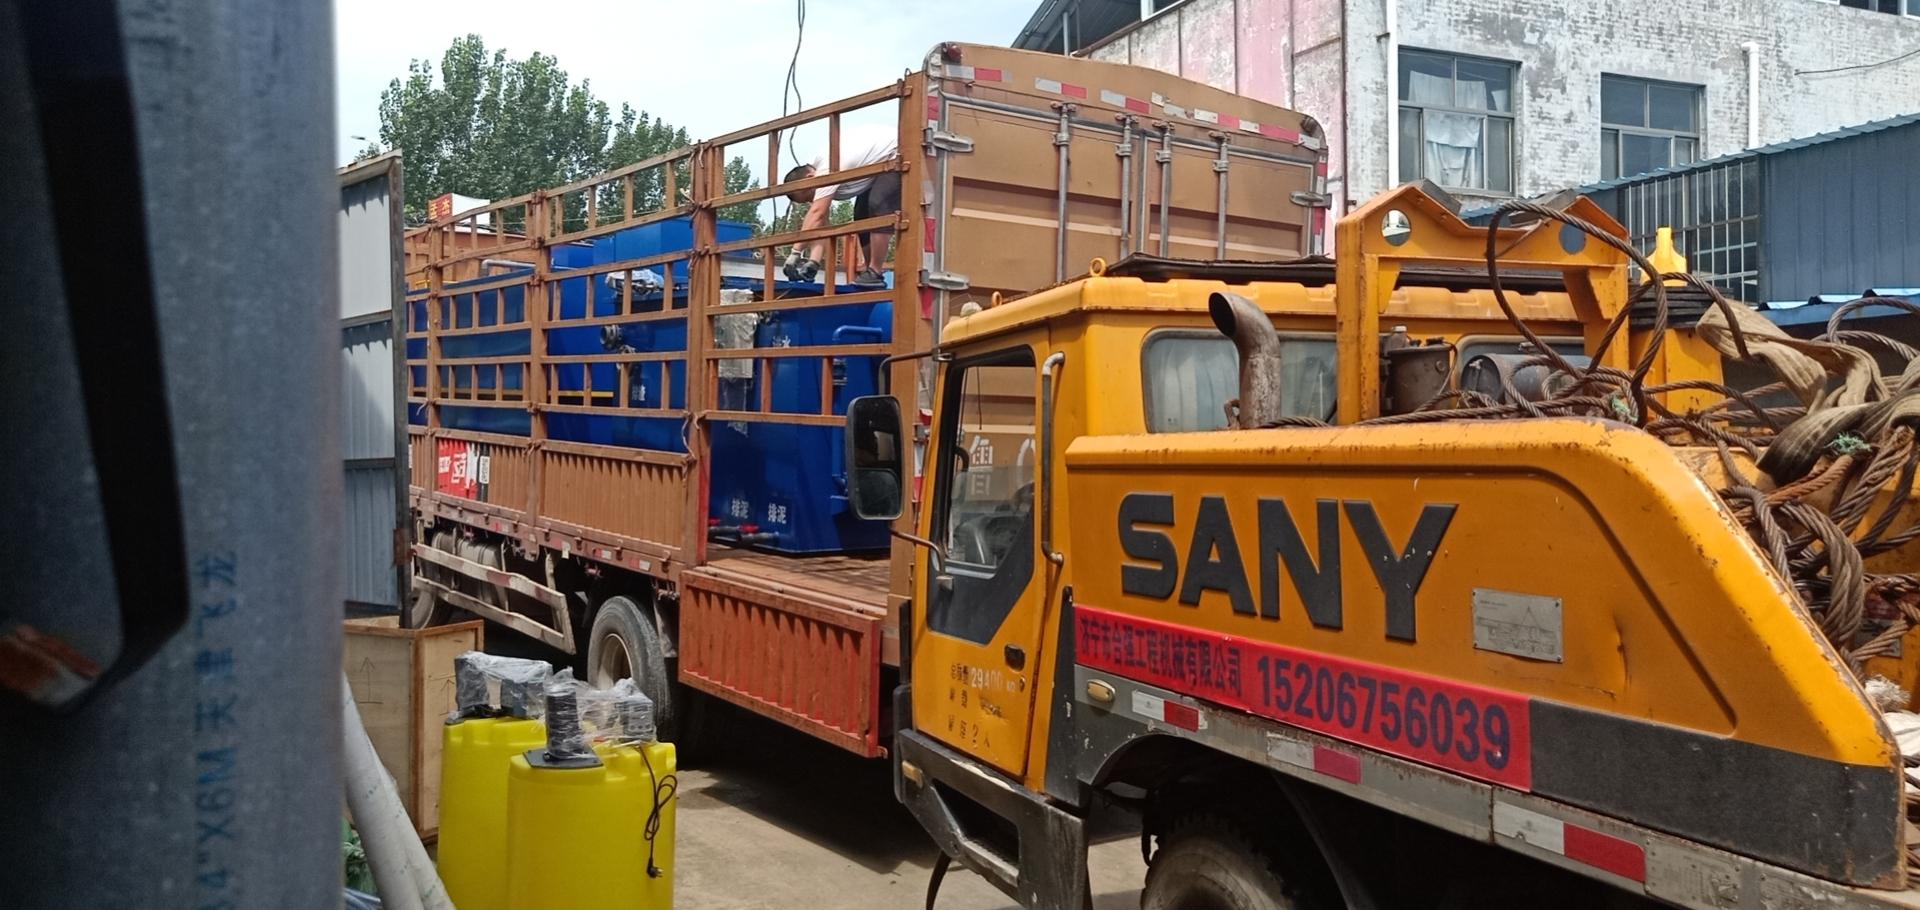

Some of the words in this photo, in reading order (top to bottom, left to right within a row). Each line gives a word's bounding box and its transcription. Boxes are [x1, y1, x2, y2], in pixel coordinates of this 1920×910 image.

[768, 502, 787, 524] 排泥
[1118, 490, 1459, 643] SANY
[1257, 655, 1511, 770] 15206756039
